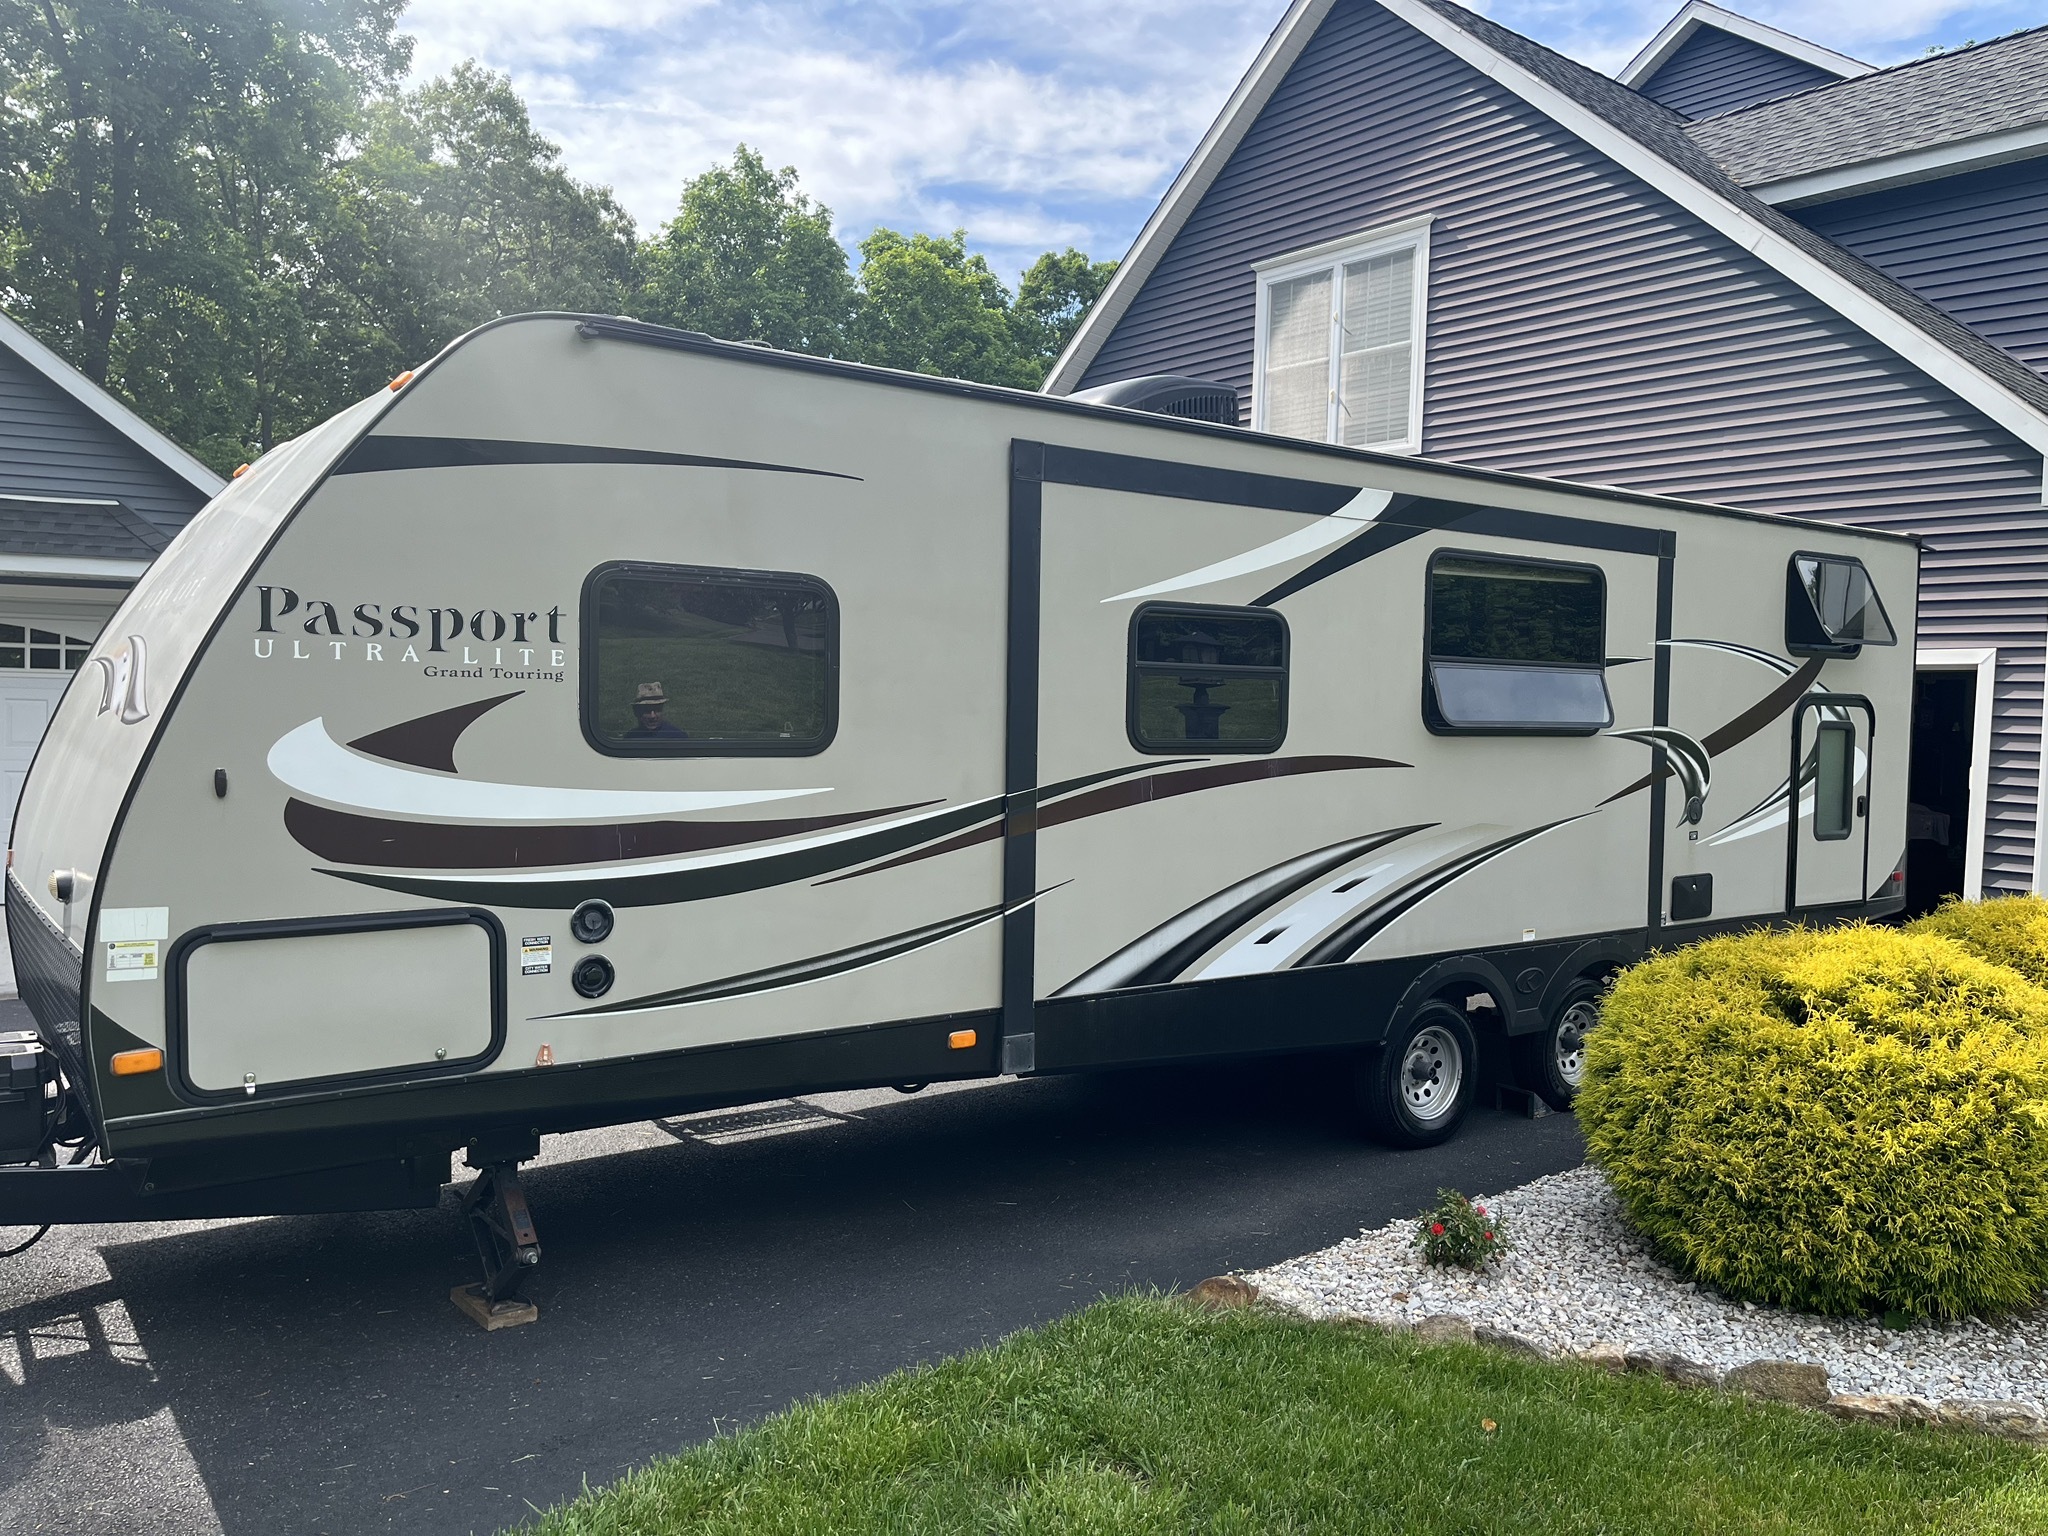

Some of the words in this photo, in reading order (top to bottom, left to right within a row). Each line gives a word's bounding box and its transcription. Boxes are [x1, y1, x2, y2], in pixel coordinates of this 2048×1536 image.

[253, 585, 568, 653] Passport
[253, 638, 420, 663] ULTRA
[463, 646, 566, 667] LITE
[423, 665, 484, 679] Grand
[489, 667, 565, 683] Touring
